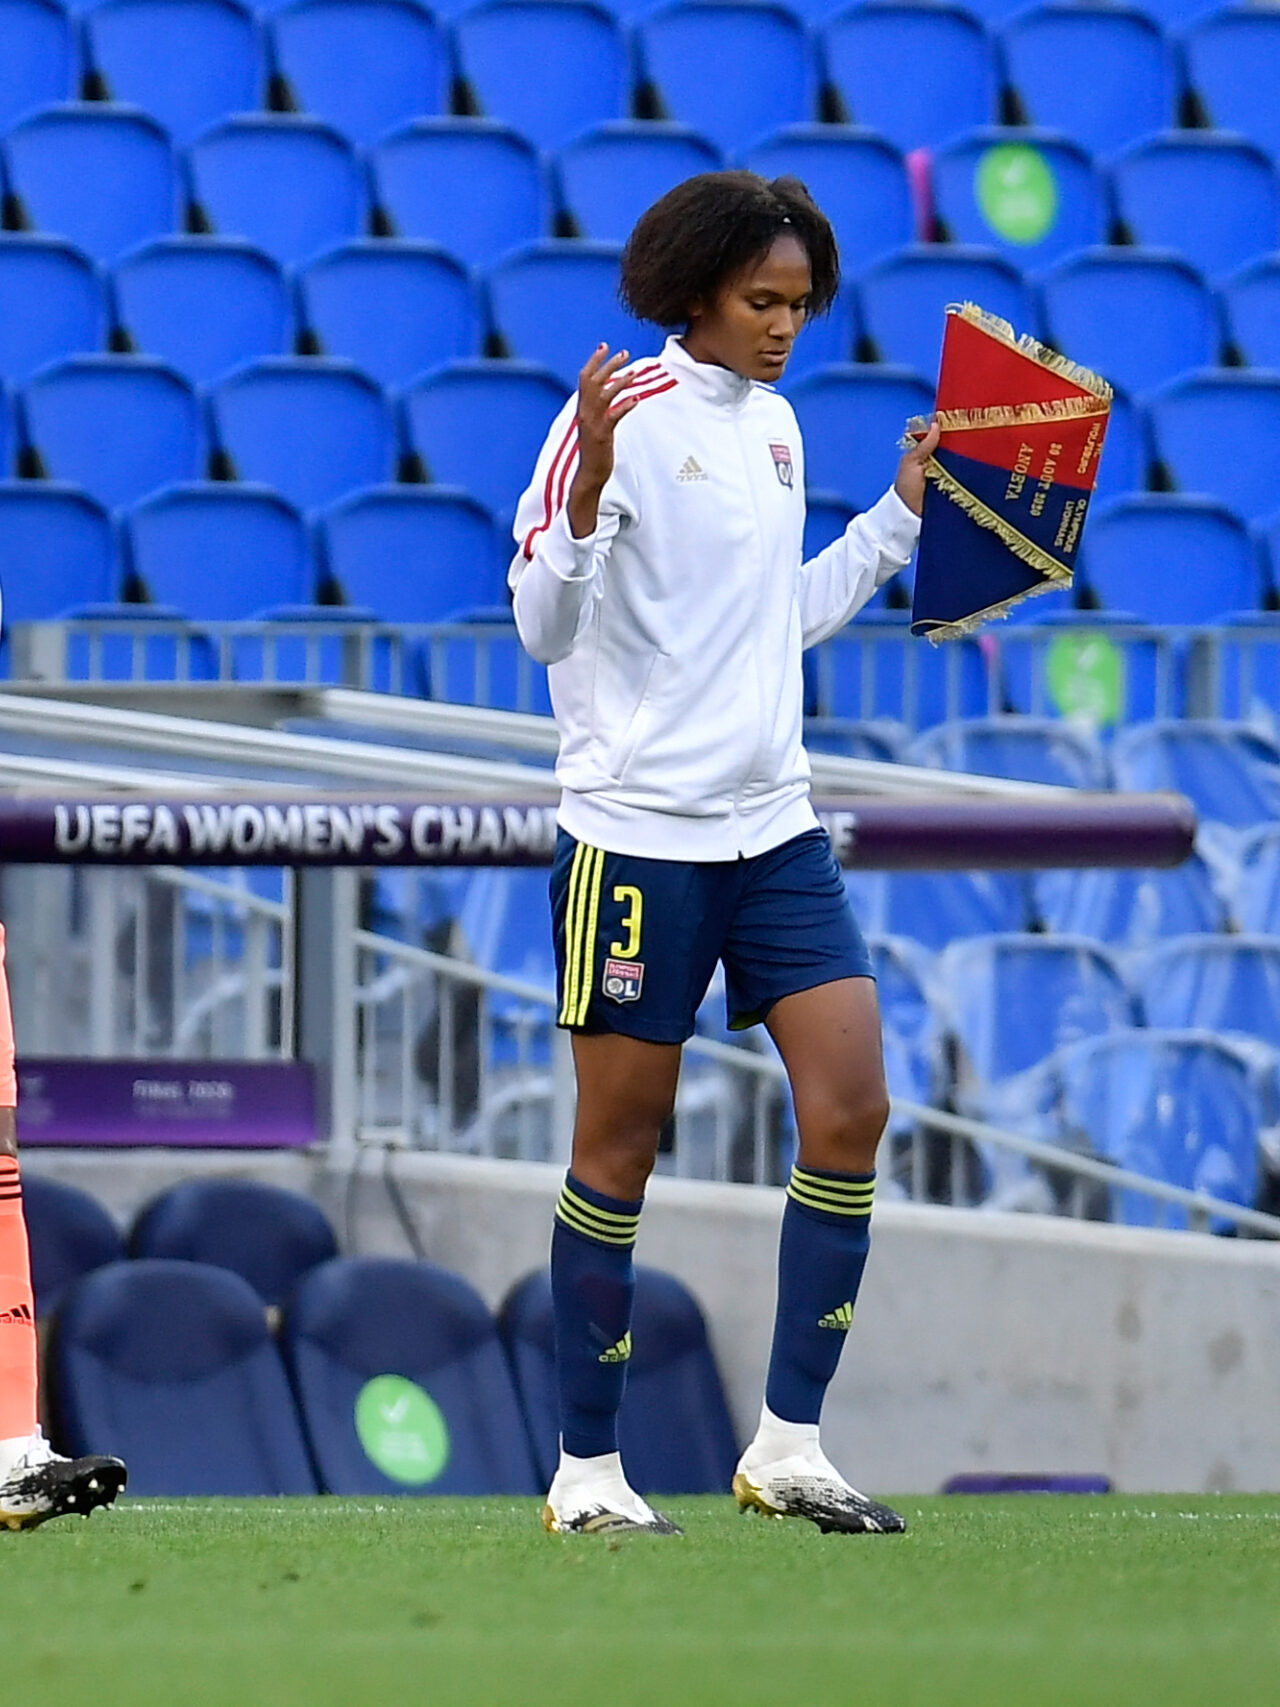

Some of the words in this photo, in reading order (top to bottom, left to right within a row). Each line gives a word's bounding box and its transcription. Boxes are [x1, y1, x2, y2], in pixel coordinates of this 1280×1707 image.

[53, 804, 179, 855] UEFA
[182, 804, 405, 856] WOMEN'S
[611, 886, 642, 958] 3
